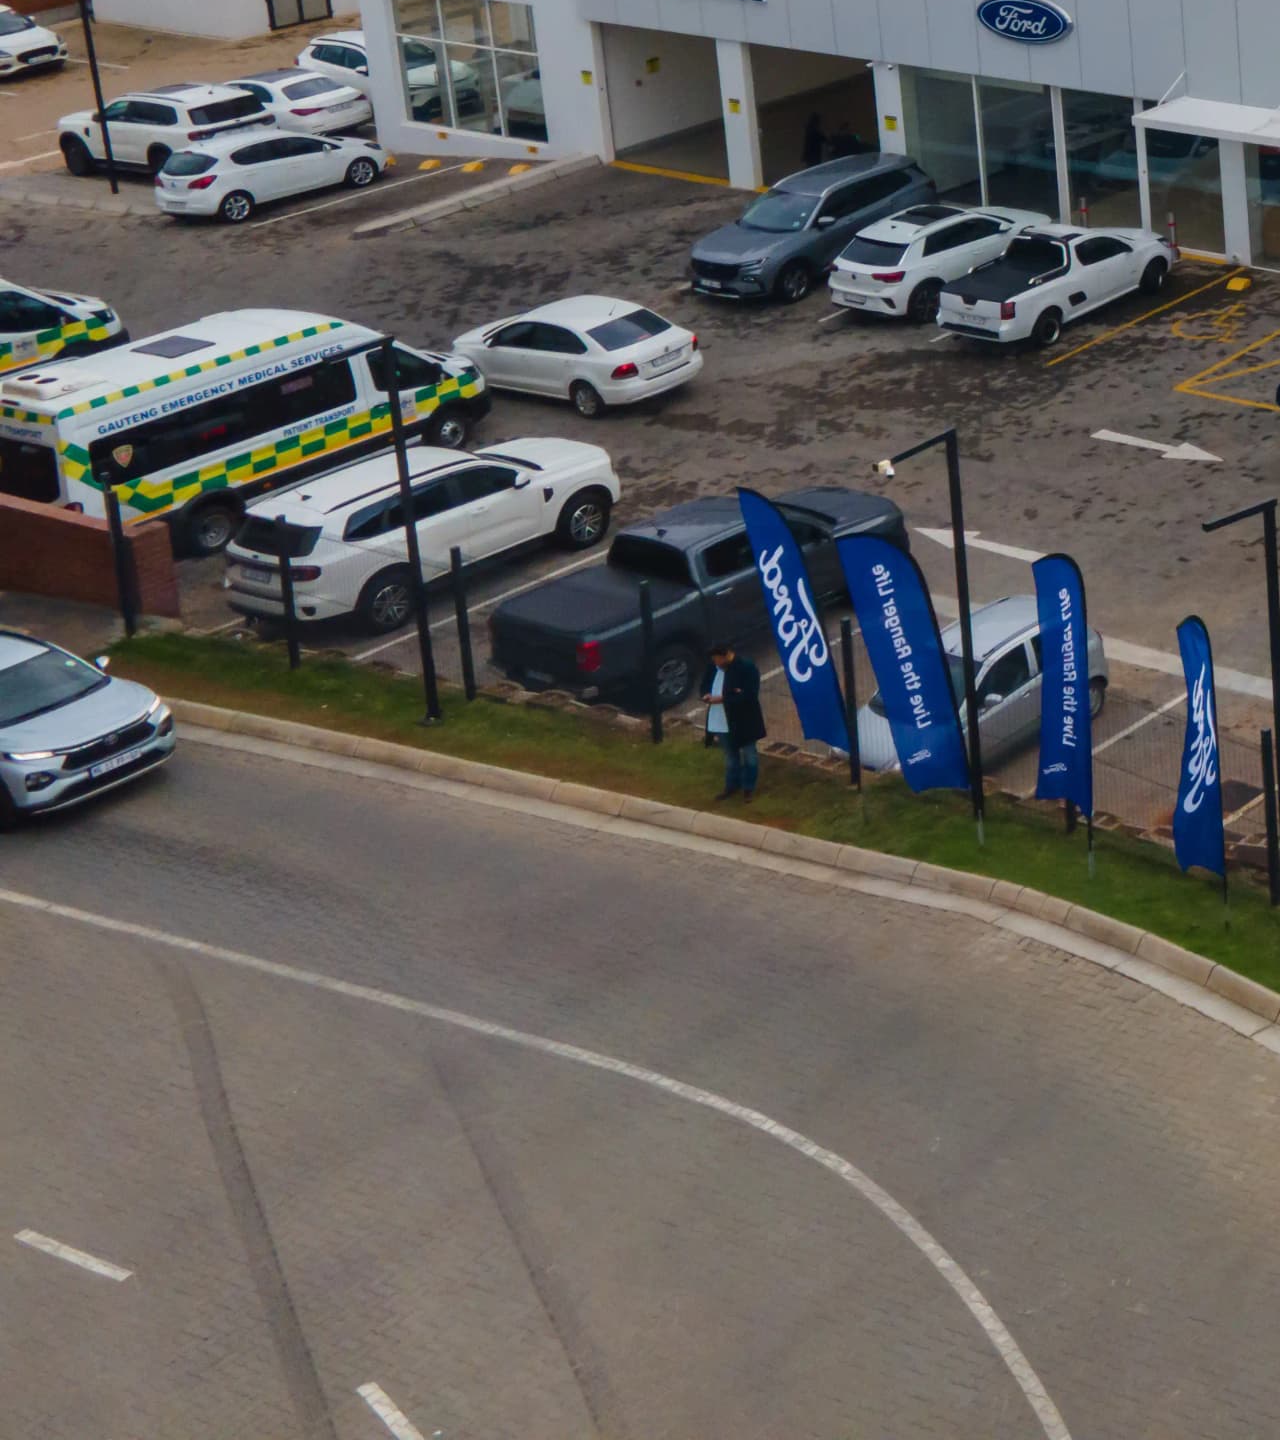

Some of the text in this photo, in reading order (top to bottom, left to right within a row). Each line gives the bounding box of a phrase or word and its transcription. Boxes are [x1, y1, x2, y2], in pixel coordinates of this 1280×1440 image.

[995, 5, 1047, 35] Ford
[97, 344, 344, 436] GAUTENG EMERGENCY MEDICAL SERVICES
[283, 405, 356, 437] PATIENT TRANSPORT
